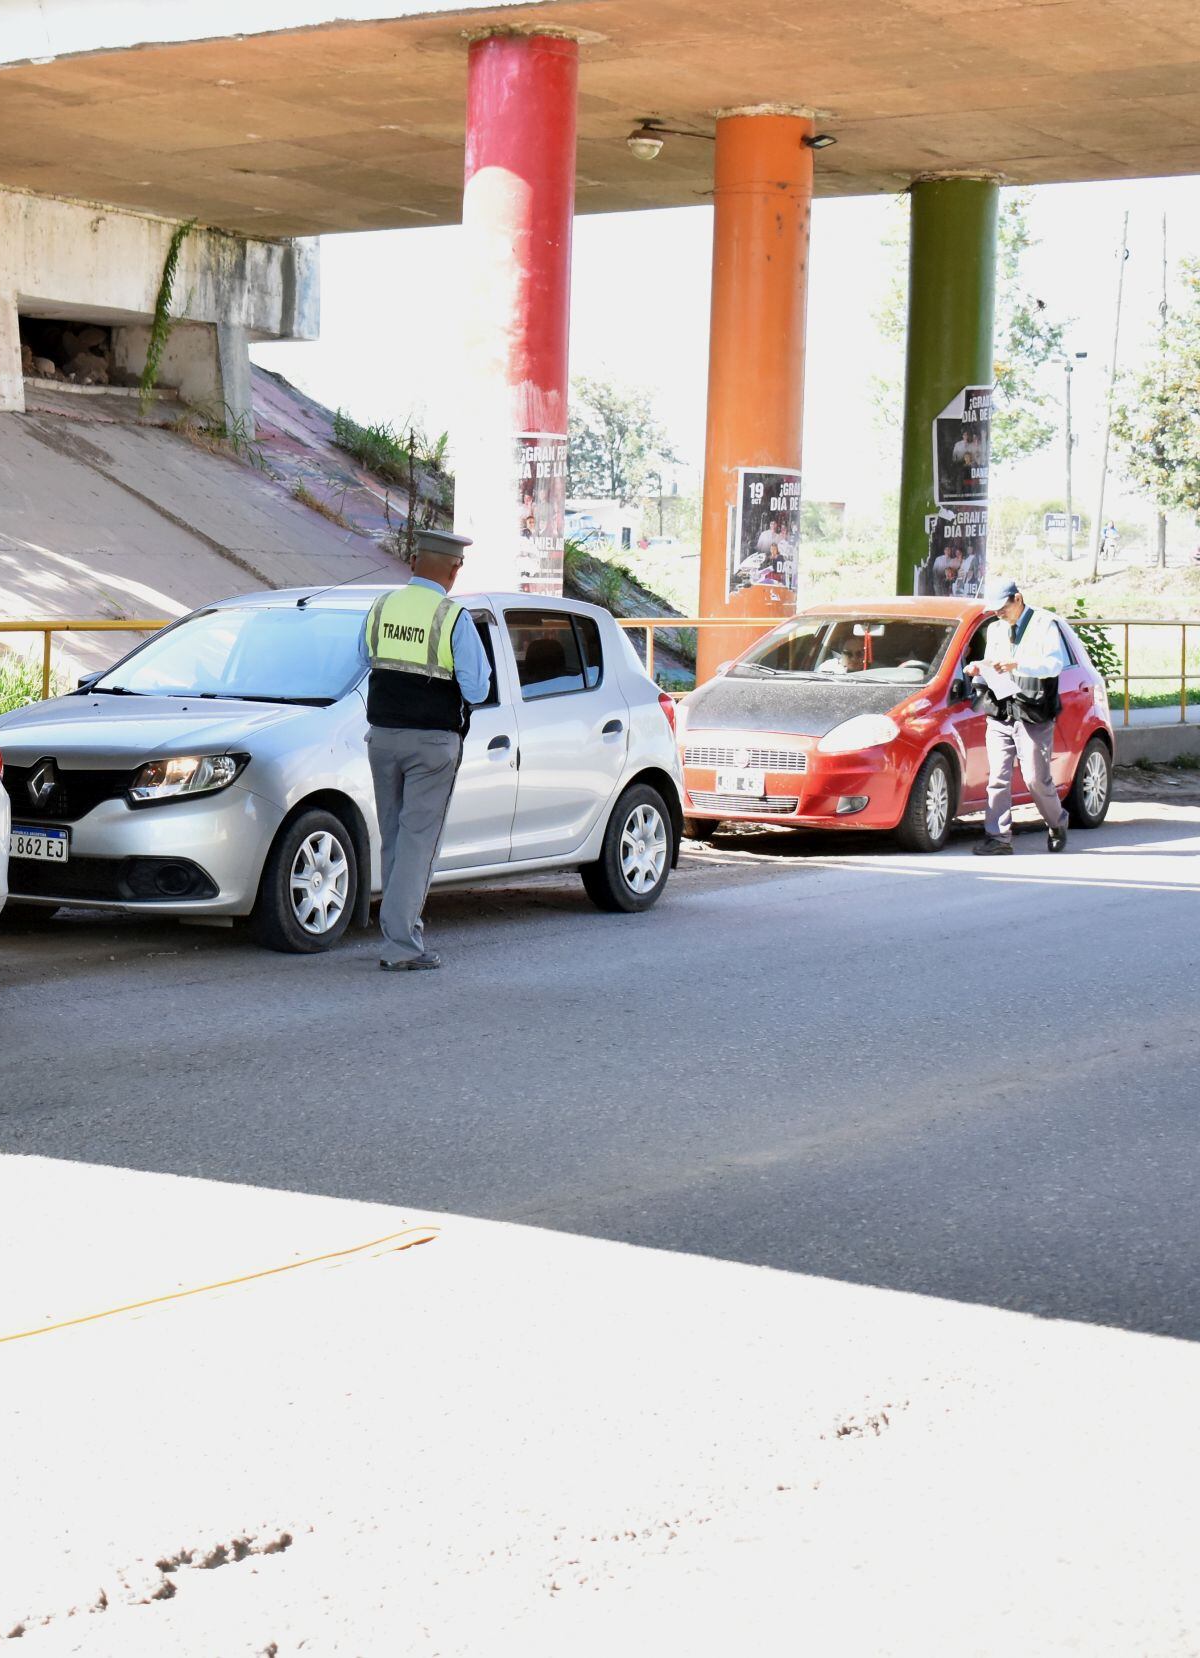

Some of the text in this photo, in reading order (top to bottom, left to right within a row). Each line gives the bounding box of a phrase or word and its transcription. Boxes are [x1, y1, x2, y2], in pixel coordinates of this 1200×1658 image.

[749, 482, 764, 499] 19
[383, 623, 425, 644] TRANSITO
[17, 837, 41, 855] 862
[46, 840, 64, 858] EJ
